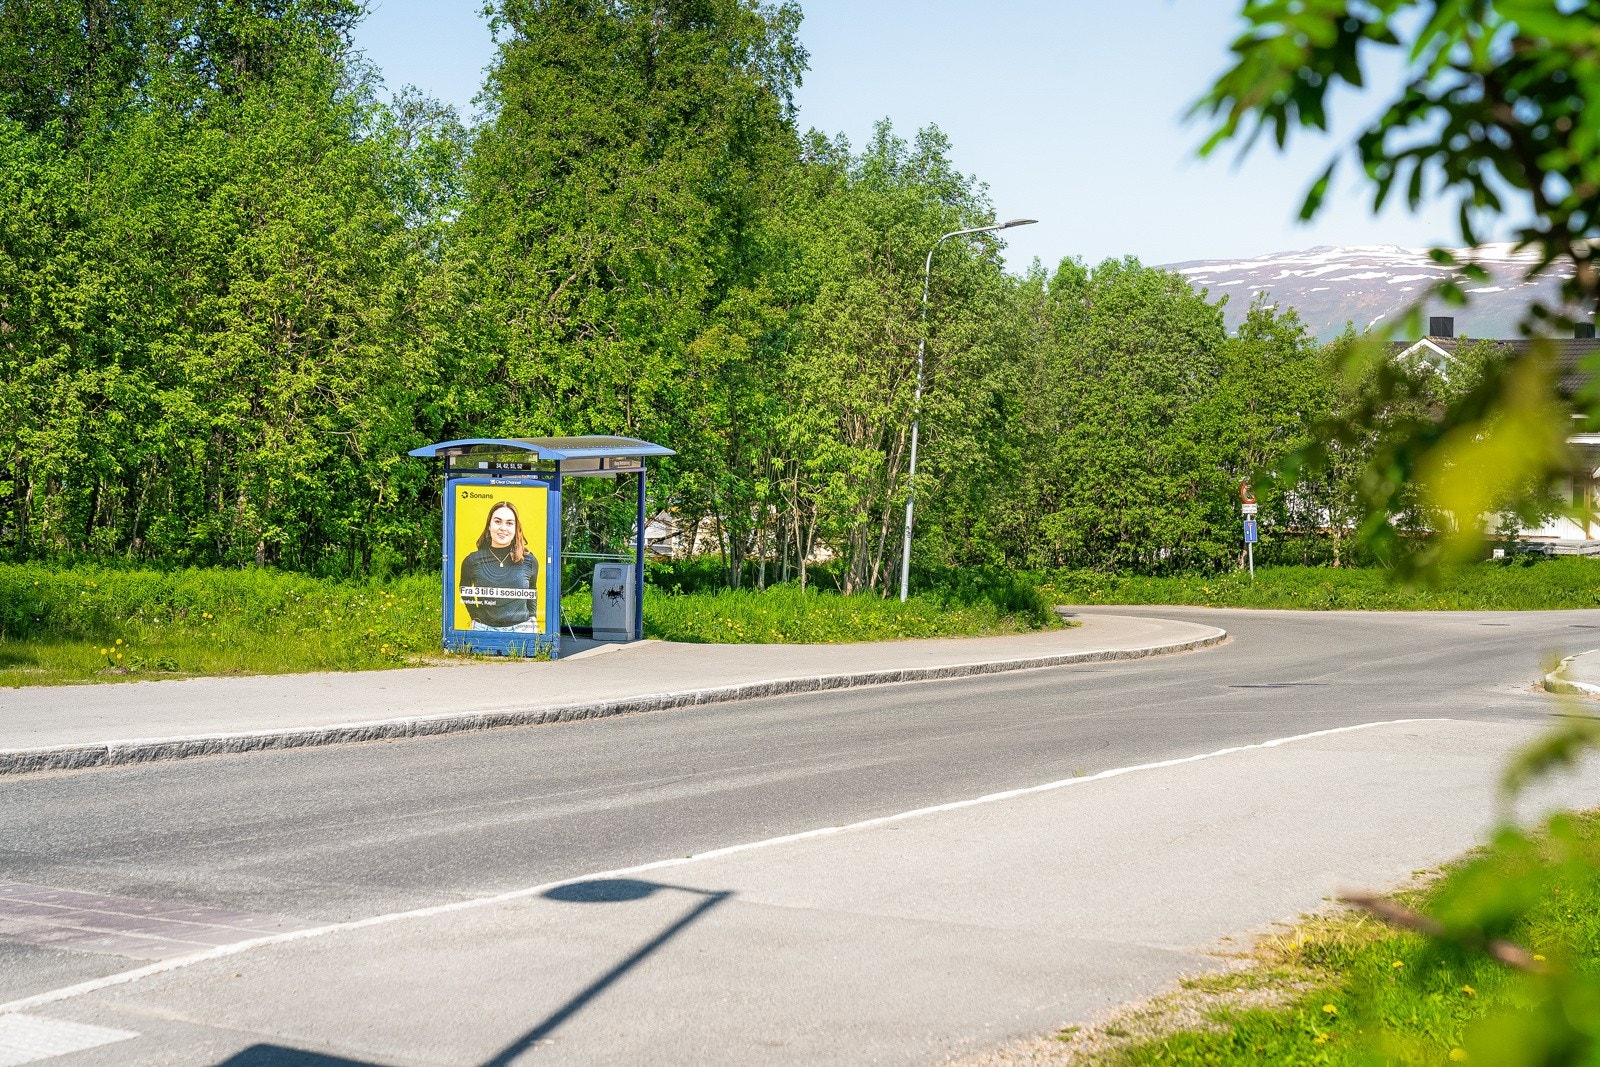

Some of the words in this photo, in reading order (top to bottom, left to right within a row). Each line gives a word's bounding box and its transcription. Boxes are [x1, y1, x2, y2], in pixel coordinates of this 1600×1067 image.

[460, 587, 473, 595] Fra
[474, 587, 480, 595] 3
[489, 588, 494, 596] 6
